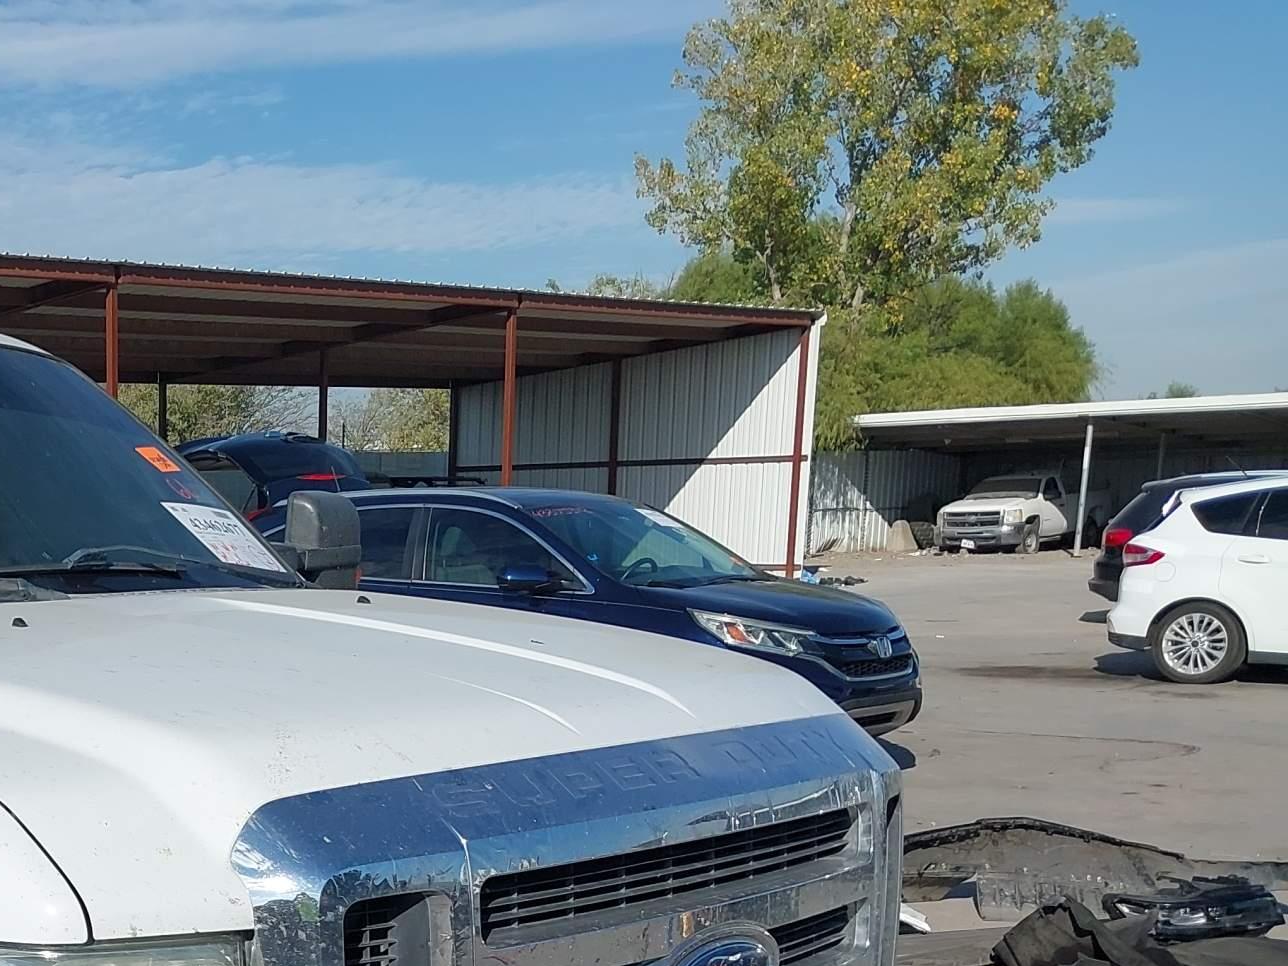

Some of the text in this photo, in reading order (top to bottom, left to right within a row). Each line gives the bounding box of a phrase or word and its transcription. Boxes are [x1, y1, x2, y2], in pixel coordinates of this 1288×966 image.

[189, 518, 245, 537] 43462677
[431, 728, 856, 818] SUPER DUTY
